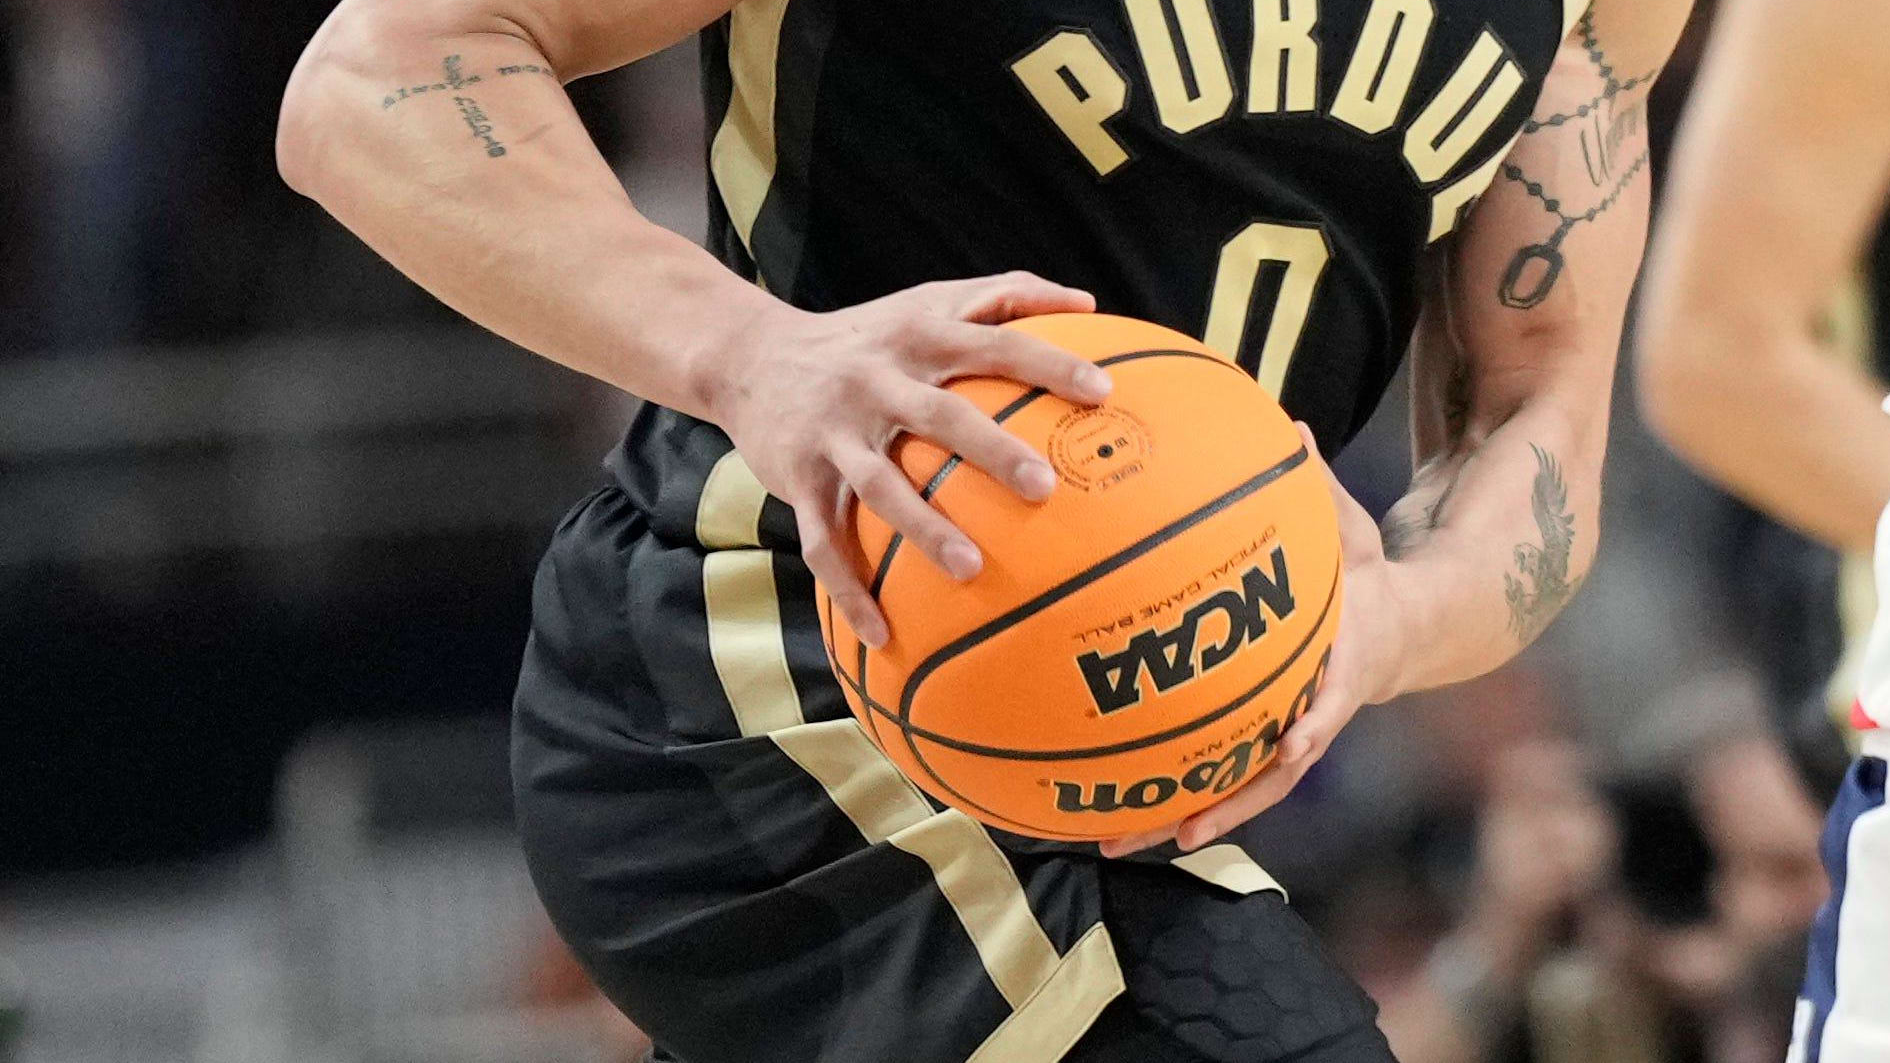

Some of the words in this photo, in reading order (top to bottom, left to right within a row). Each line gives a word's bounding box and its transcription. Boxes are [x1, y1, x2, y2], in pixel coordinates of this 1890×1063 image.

[1202, 221, 1331, 398] 0
[1209, 524, 1277, 581] OFFICIAL
[1139, 581, 1202, 616] GAME
[1071, 614, 1134, 644] BALL
[1075, 544, 1296, 716] NCAA
